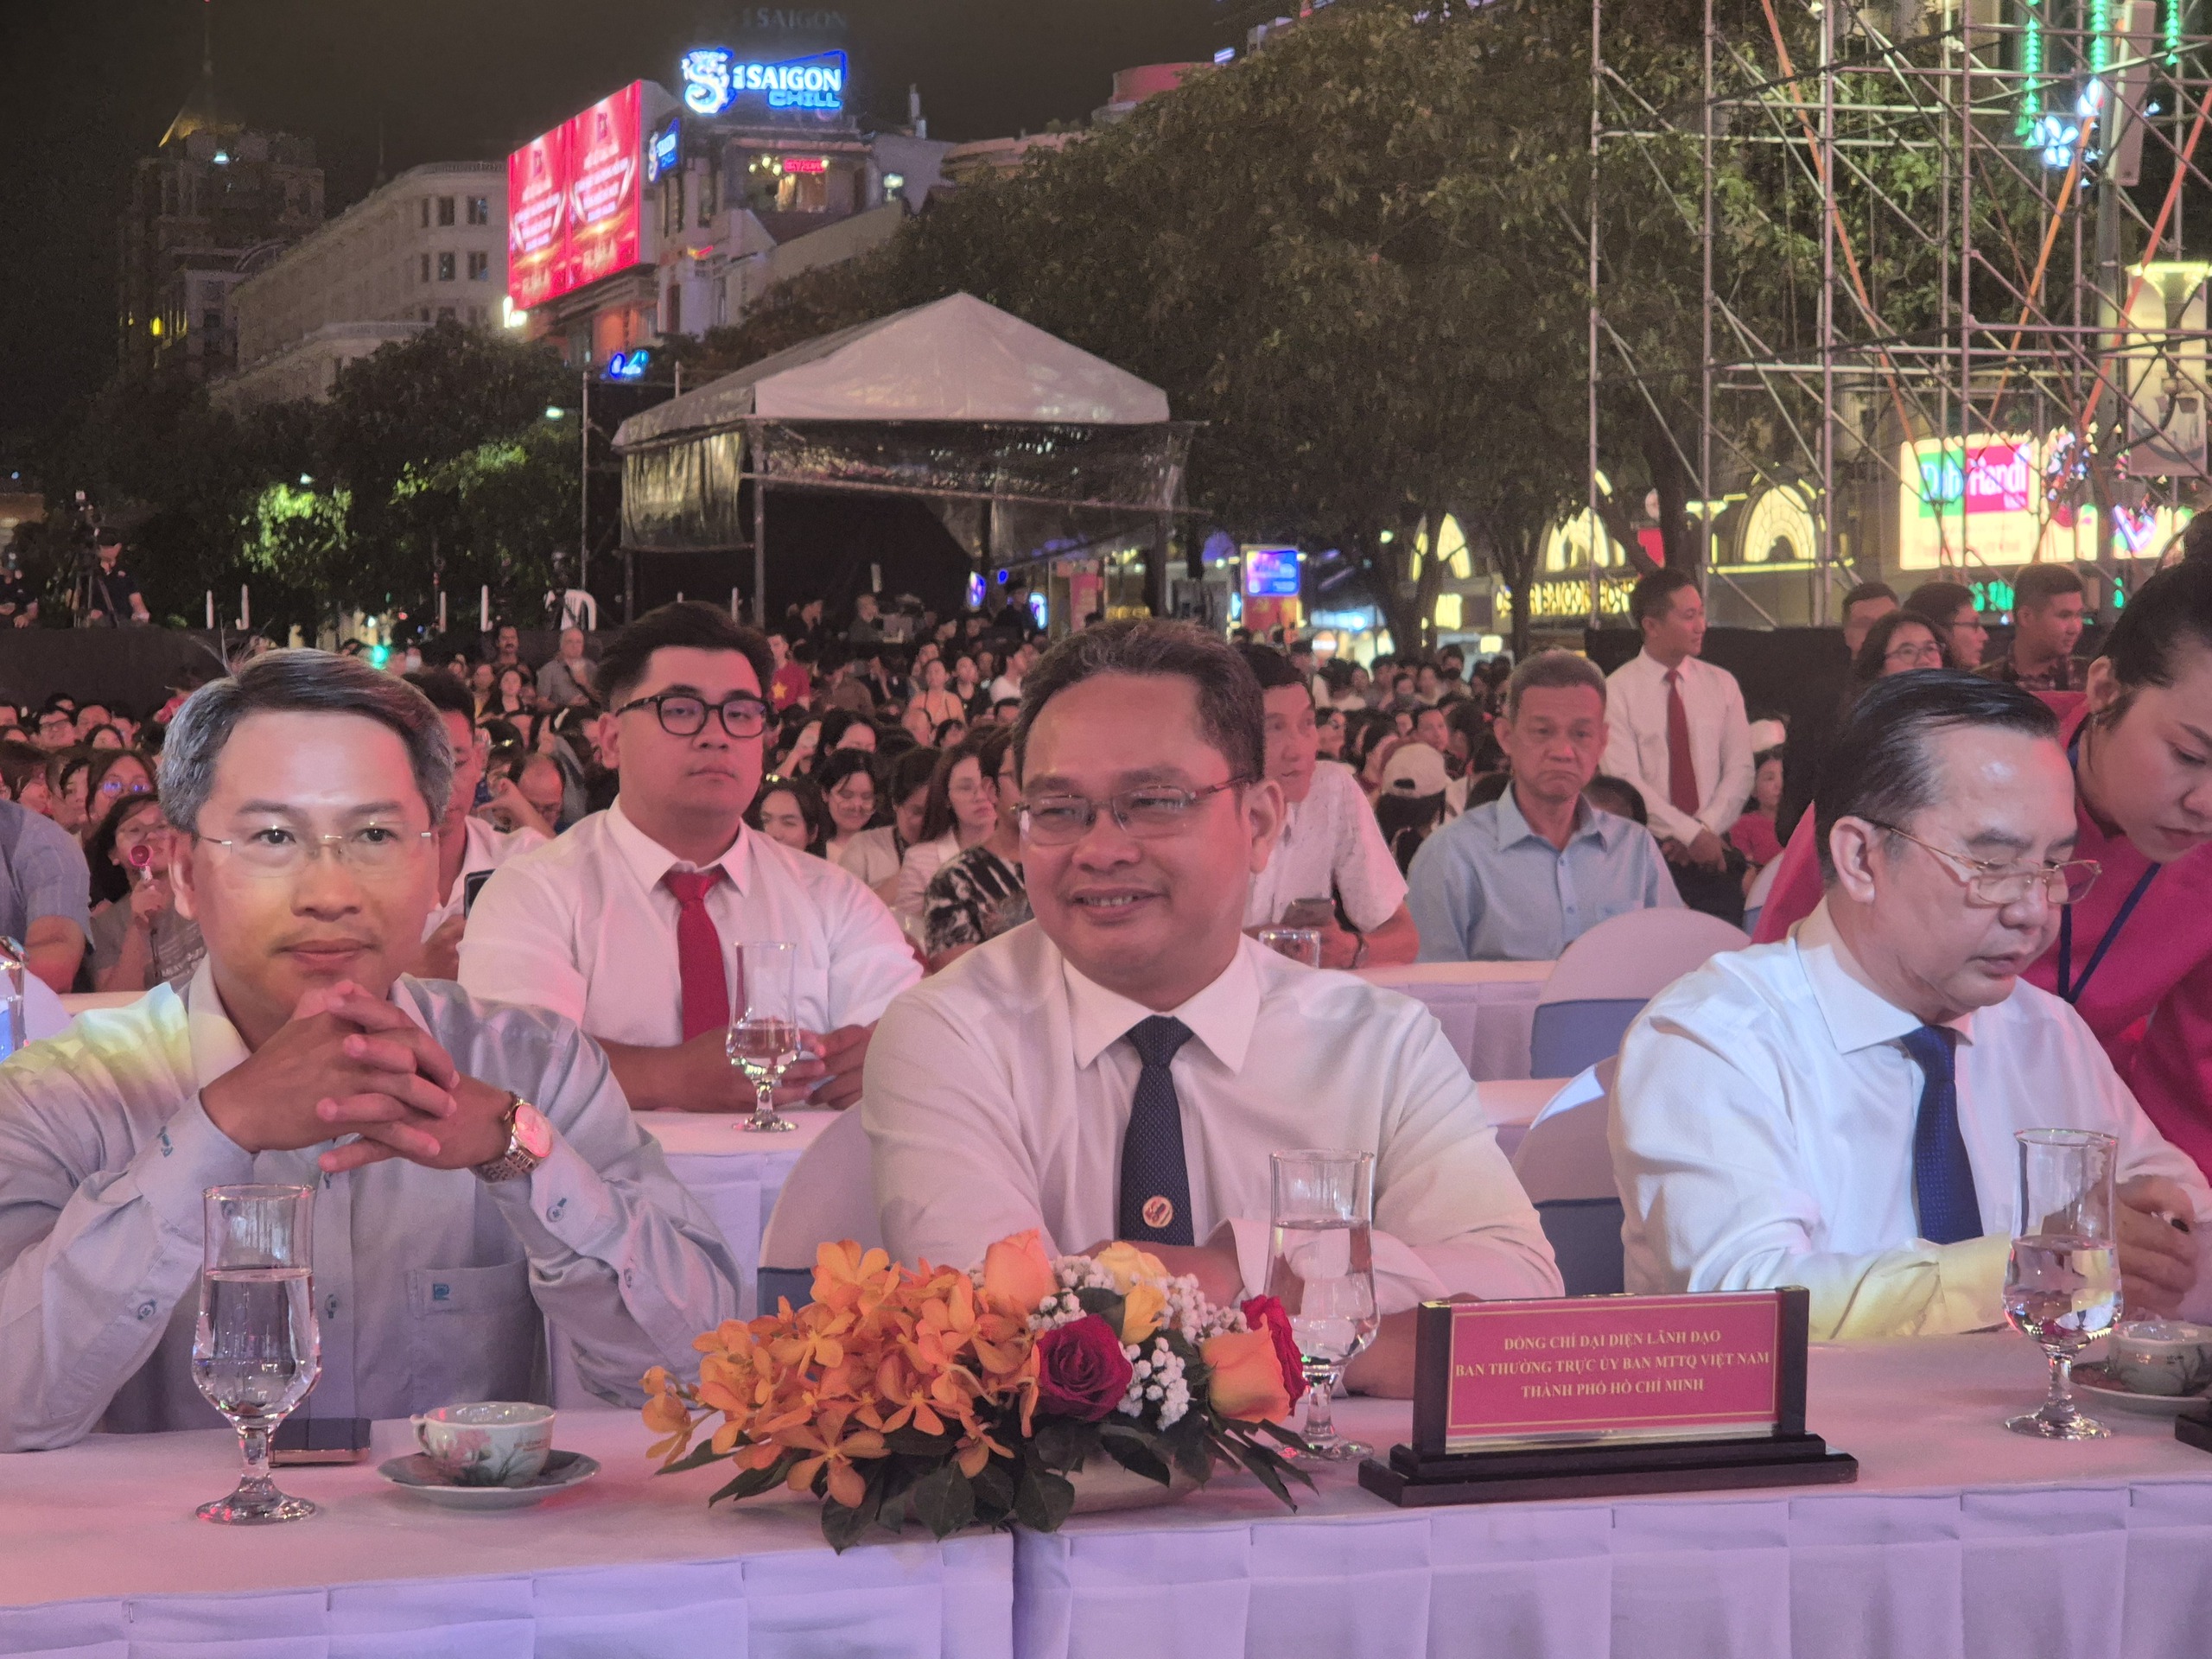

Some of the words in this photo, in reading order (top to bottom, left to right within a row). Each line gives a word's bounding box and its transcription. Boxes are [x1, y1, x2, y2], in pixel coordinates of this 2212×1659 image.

[768, 89, 841, 108] CHILL
[1549, 1332, 1576, 1349] CHÍ
[1609, 1332, 1643, 1348] DIỆN
[1647, 1330, 1687, 1344] LÃNH
[1455, 1363, 1485, 1377] BAN
[1489, 1357, 1552, 1375] THƯỜNG
[1555, 1357, 1597, 1374] TRỰC
[1623, 1357, 1651, 1370] BAN
[1656, 1354, 1698, 1369] MTTQ
[1700, 1352, 1735, 1368] VIỆT
[1736, 1351, 1770, 1364] NAM
[1521, 1382, 1573, 1398] THÀNH
[1576, 1380, 1607, 1395] PHỐ
[1610, 1378, 1632, 1395] HỒ
[1635, 1377, 1662, 1393] CHÍ
[1664, 1378, 1704, 1392] MINH
